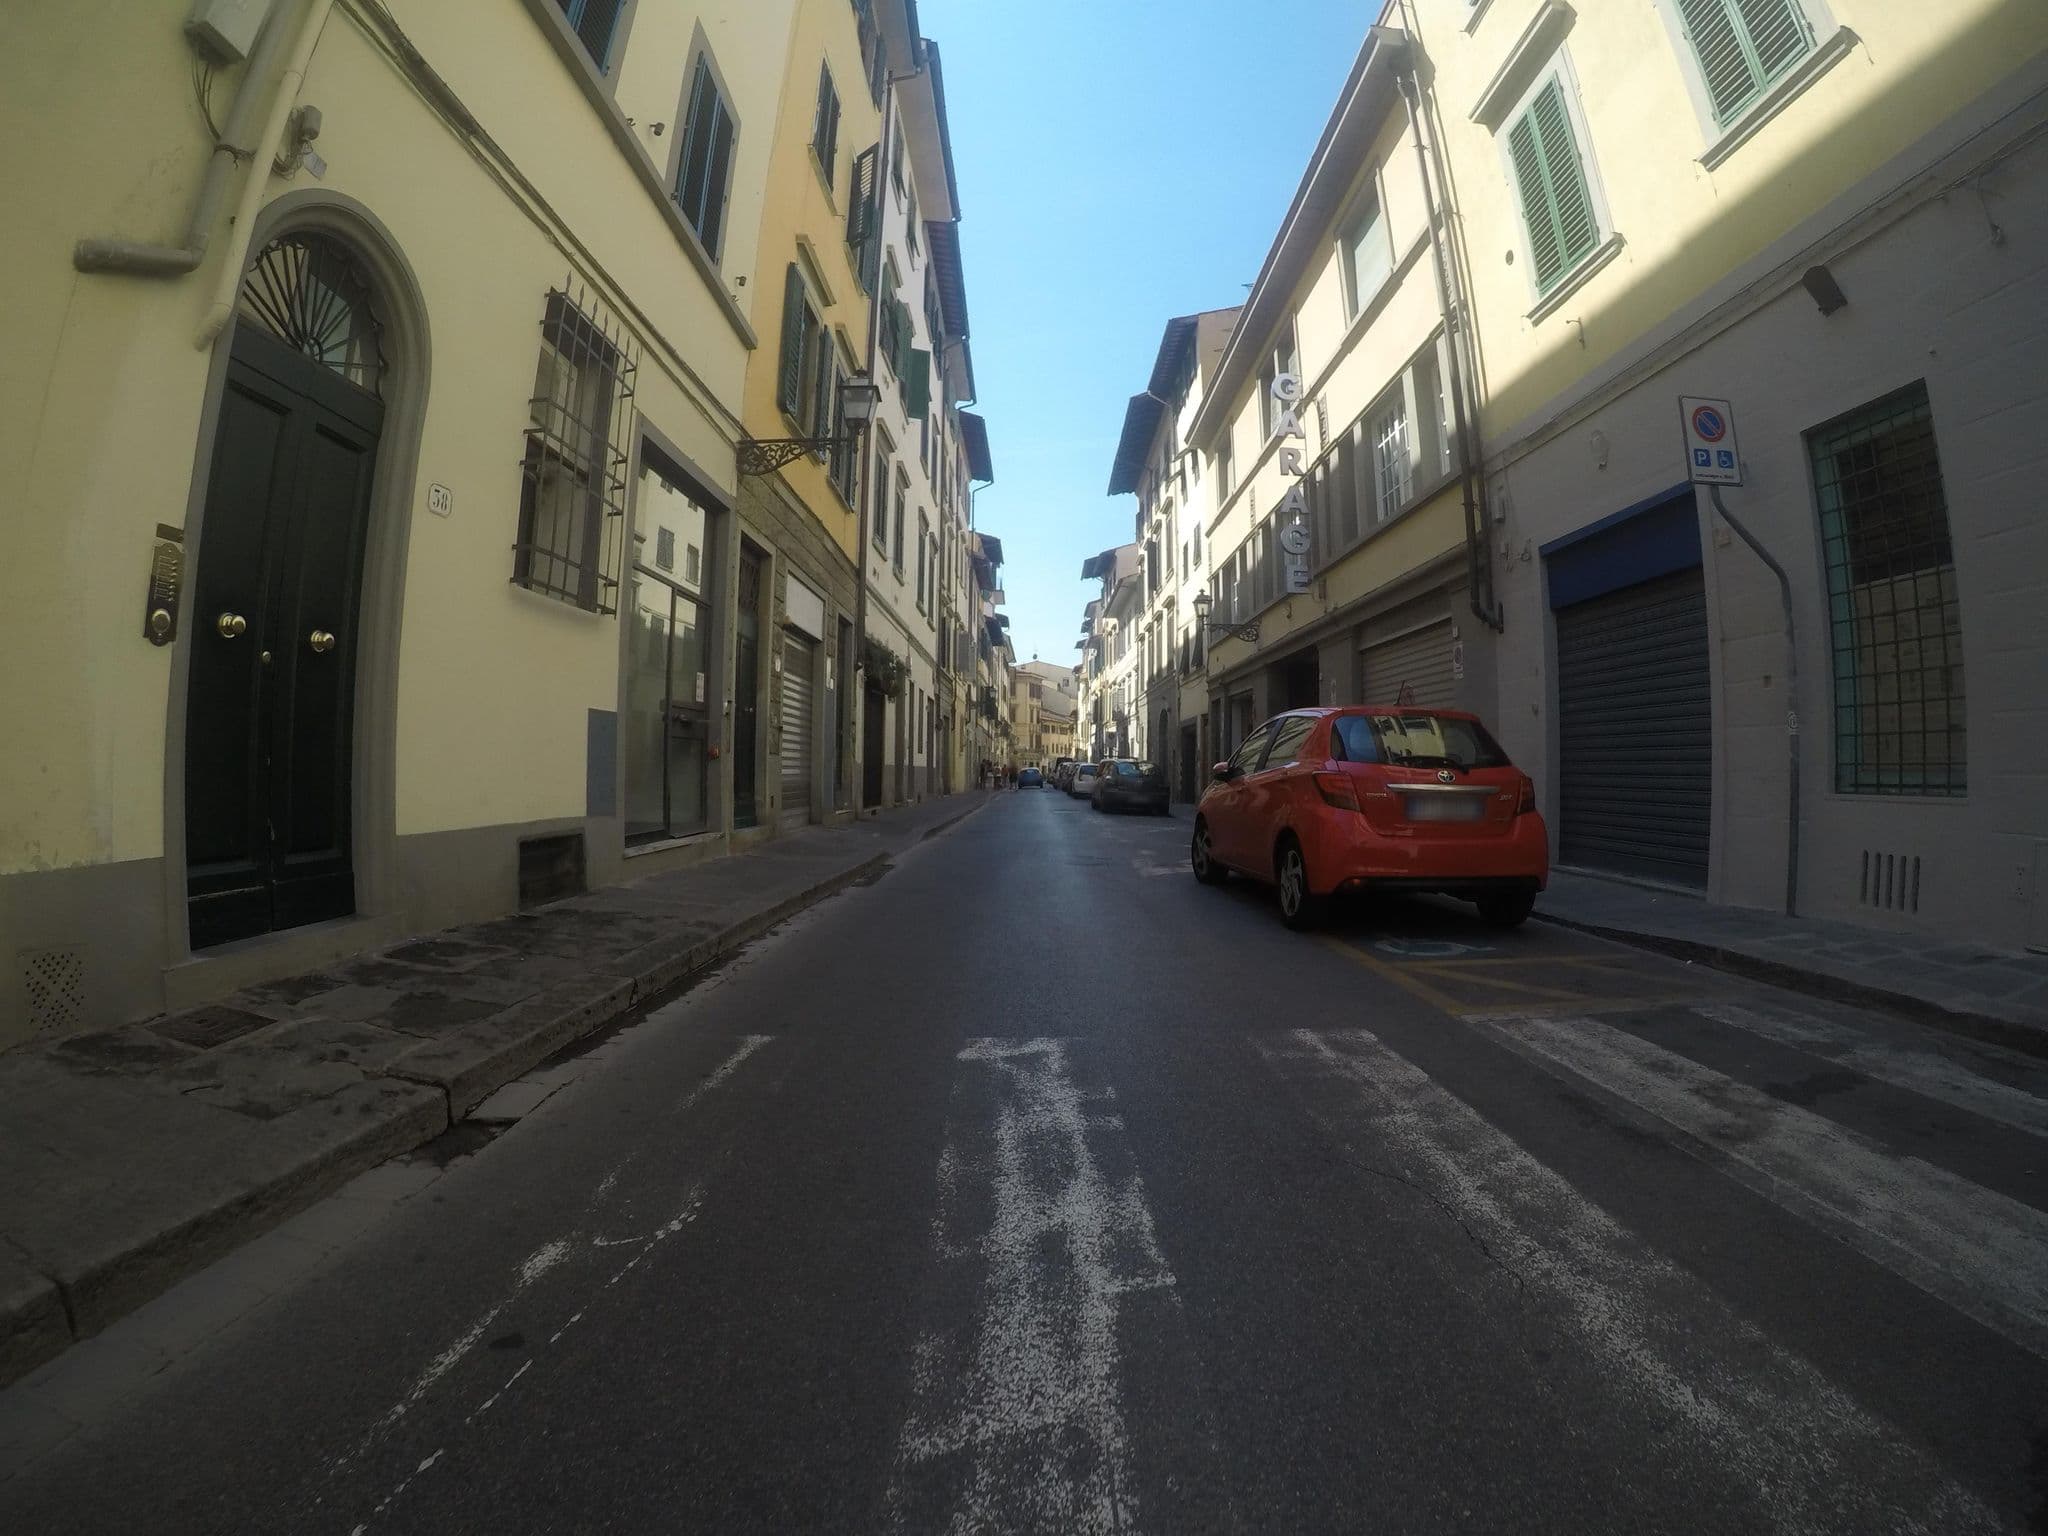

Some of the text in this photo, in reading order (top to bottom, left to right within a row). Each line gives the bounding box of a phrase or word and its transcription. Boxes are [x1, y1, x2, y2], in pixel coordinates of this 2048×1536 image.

[1697, 451, 1707, 465] P
[1271, 373, 1312, 594] GARAGE
[433, 488, 448, 510] 38
